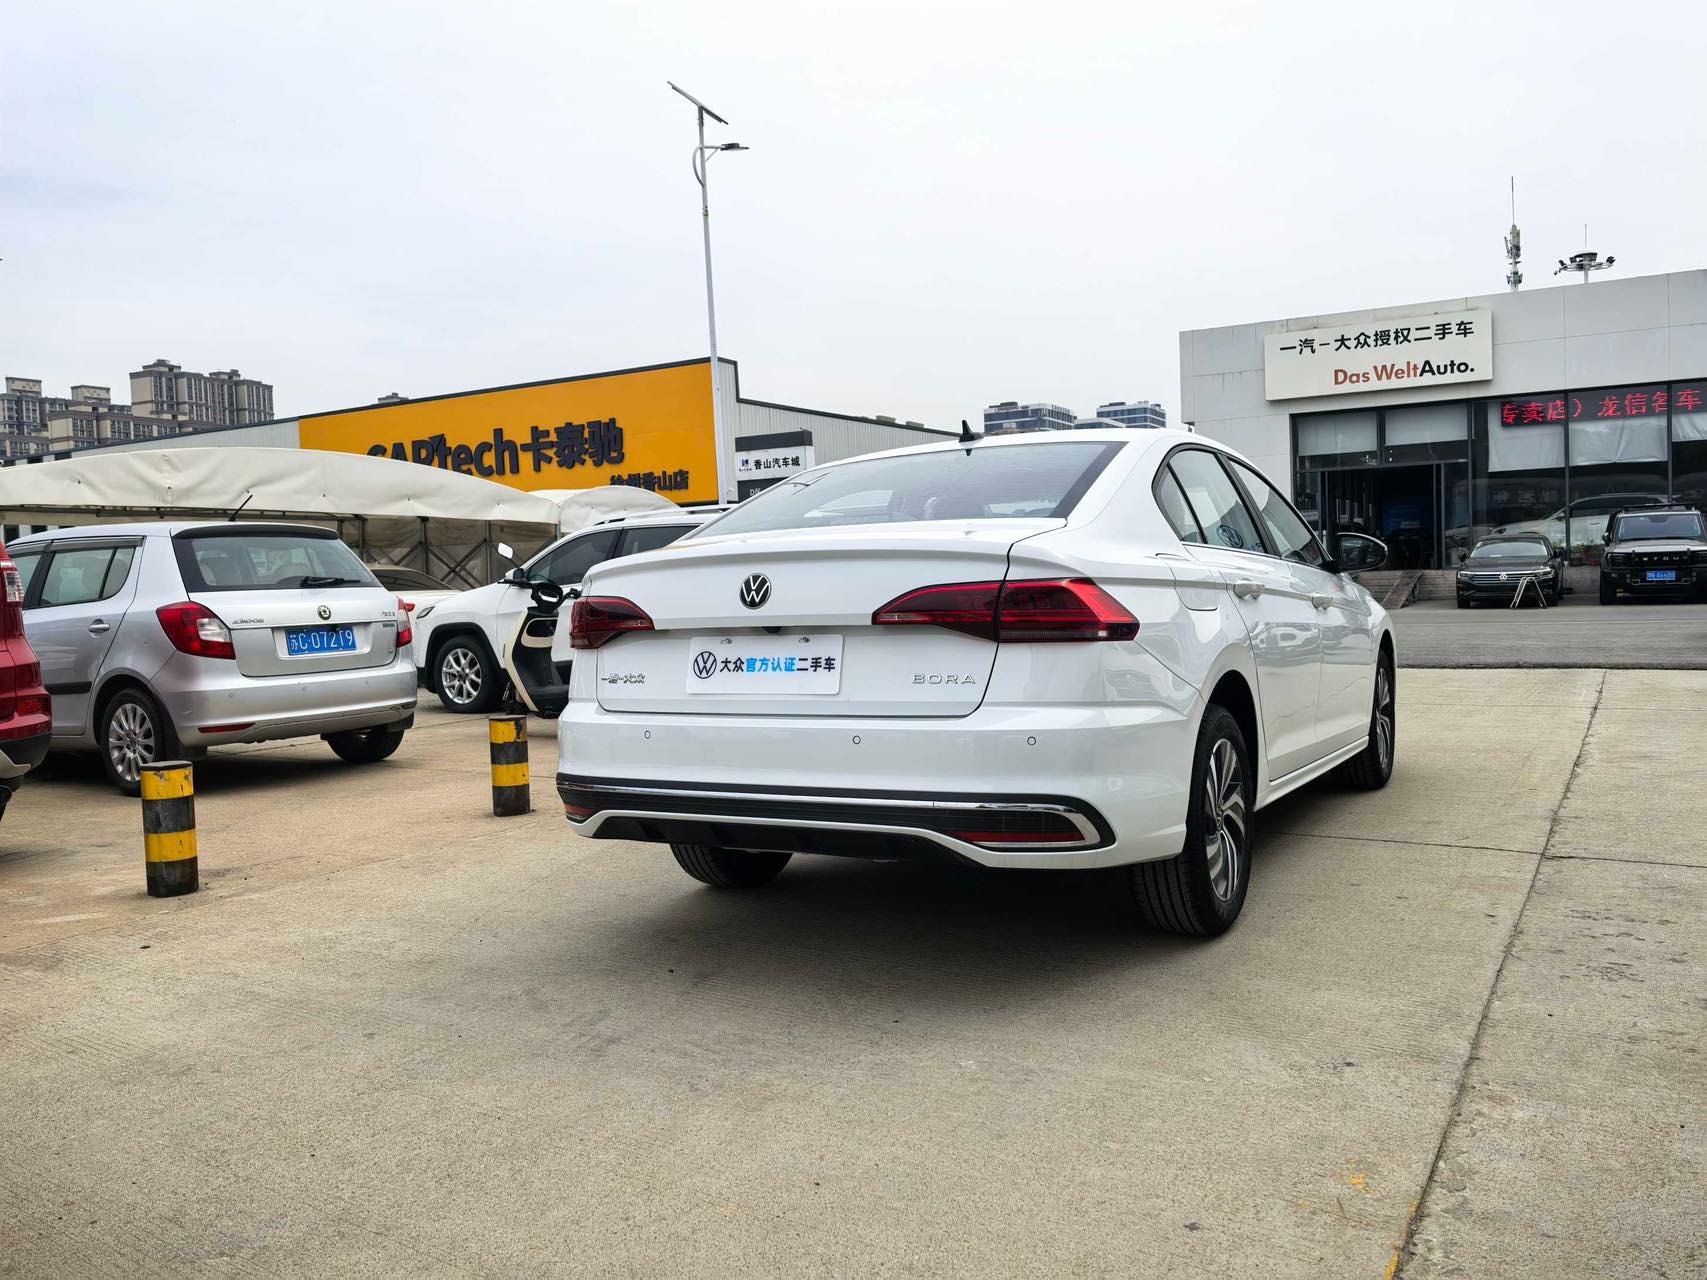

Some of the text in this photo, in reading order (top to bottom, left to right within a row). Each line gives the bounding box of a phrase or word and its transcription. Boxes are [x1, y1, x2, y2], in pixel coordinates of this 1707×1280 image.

[1333, 368, 1370, 385] Das
[754, 456, 800, 471] 香山汽车城
[720, 656, 836, 673] 大众官方认证二手车
[912, 673, 976, 685] BORA
